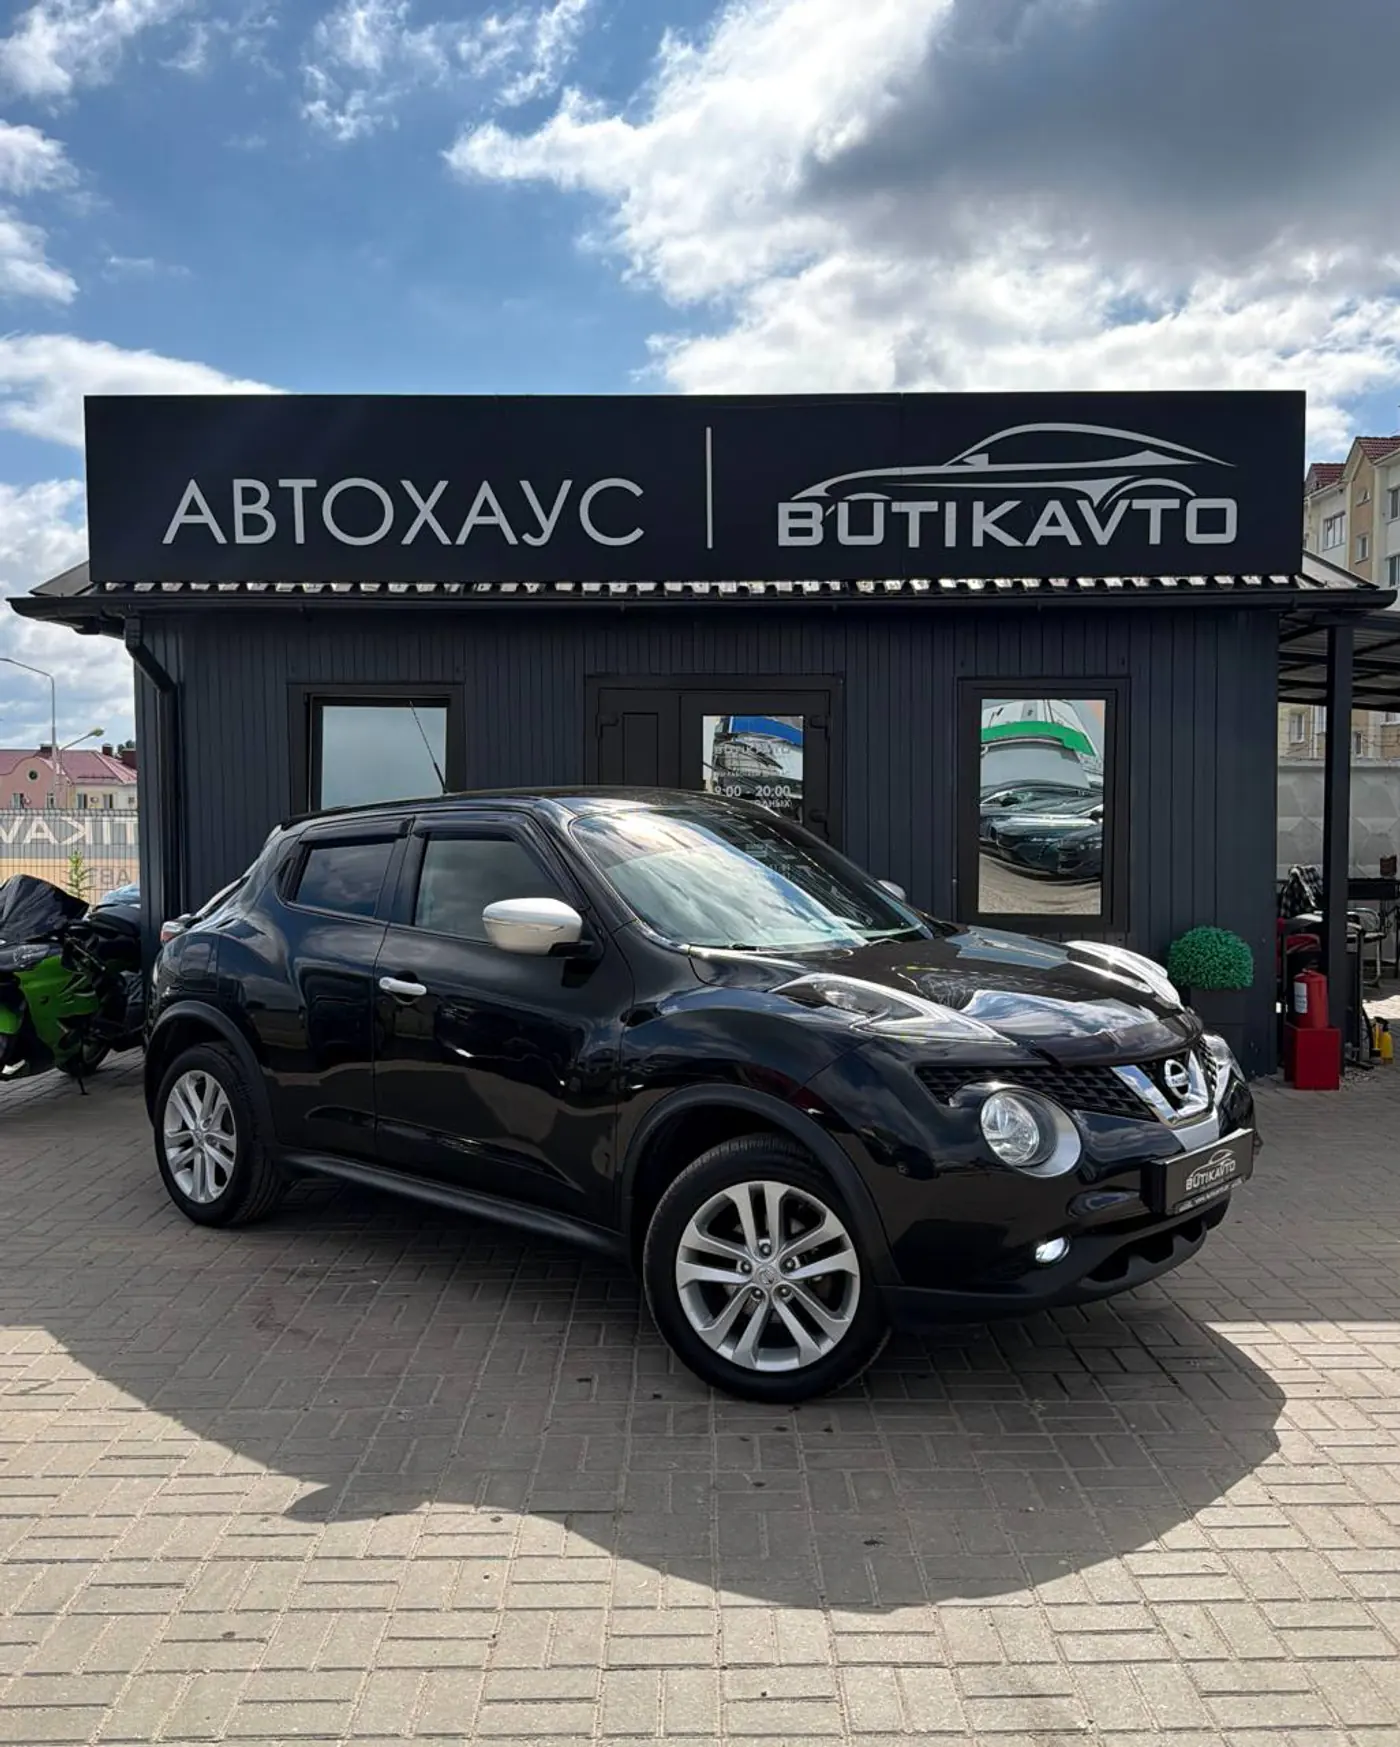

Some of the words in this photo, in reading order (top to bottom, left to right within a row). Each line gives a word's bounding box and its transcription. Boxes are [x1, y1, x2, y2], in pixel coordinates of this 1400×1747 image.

[162, 477, 645, 547] АВТОХАУС
[777, 497, 1238, 547] BUTIKAVTO
[755, 785, 791, 798] 20:00
[1185, 1159, 1236, 1191] BUTIKAVTO
